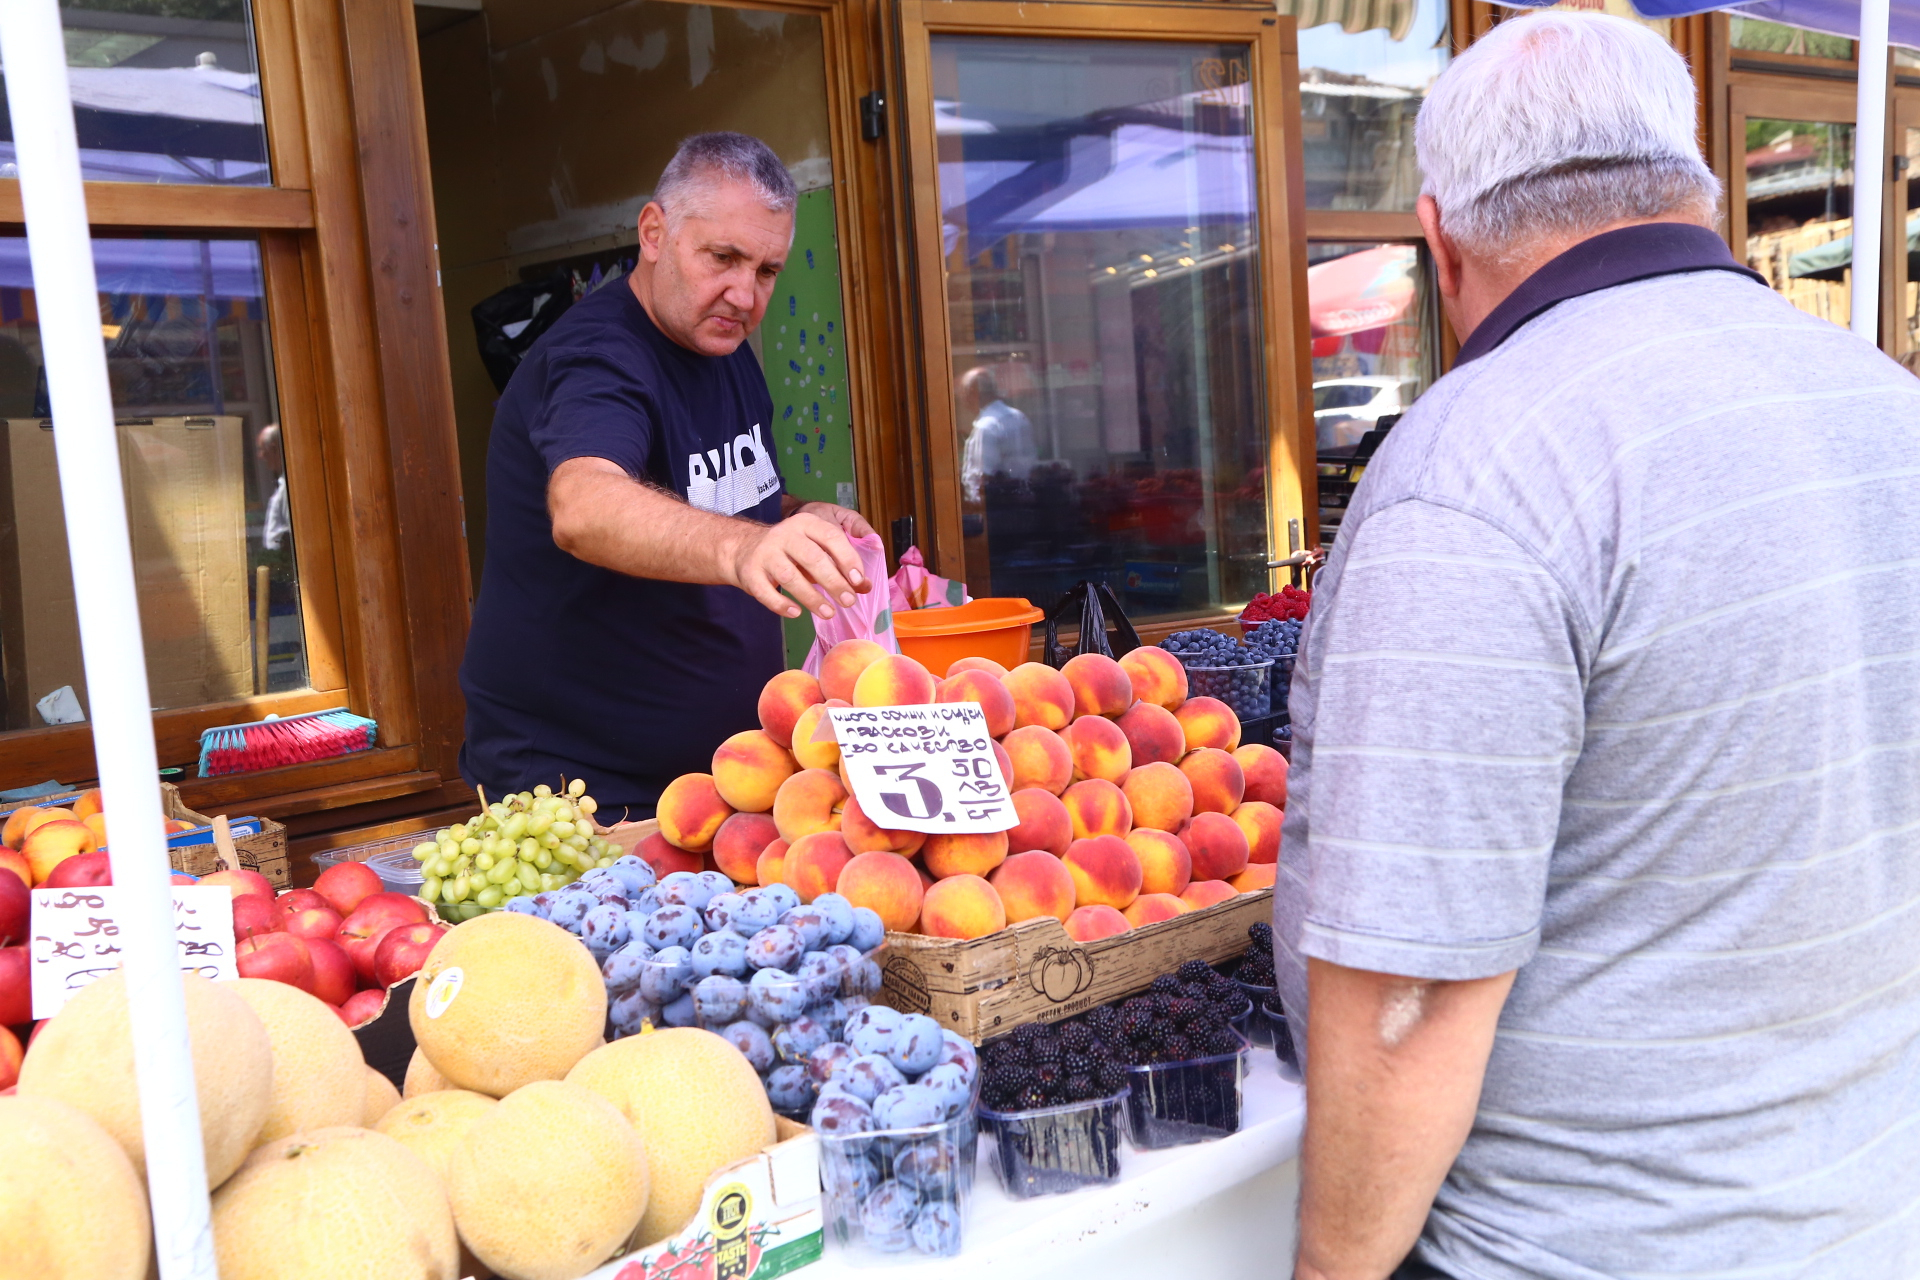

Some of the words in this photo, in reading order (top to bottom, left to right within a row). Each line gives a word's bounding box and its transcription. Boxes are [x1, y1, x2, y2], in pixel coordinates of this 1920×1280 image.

[951, 757, 992, 779] 50
[1063, 996, 1092, 1014] PRODUCT
[717, 1241, 747, 1265] TASTE
